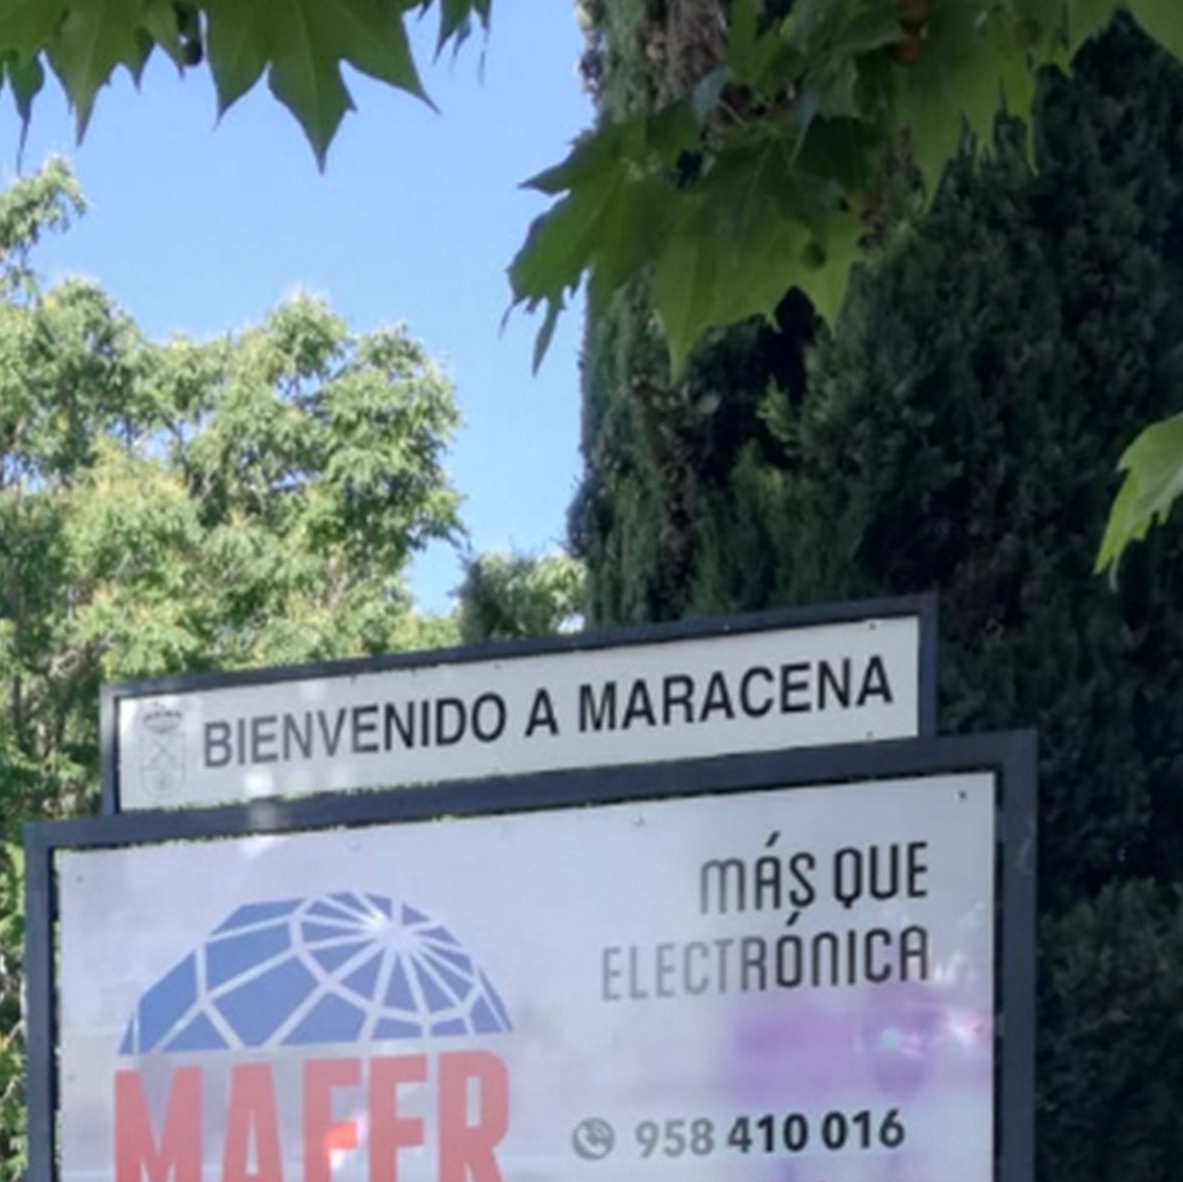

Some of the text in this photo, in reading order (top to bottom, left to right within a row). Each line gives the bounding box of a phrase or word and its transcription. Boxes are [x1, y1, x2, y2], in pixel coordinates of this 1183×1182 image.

[203, 655, 894, 768] BIENVENIDO A MARACENA
[699, 831, 927, 915] MÁS QUE
[601, 909, 929, 1001] ELECTRÓNICA
[634, 1109, 905, 1158] 958 410 016
